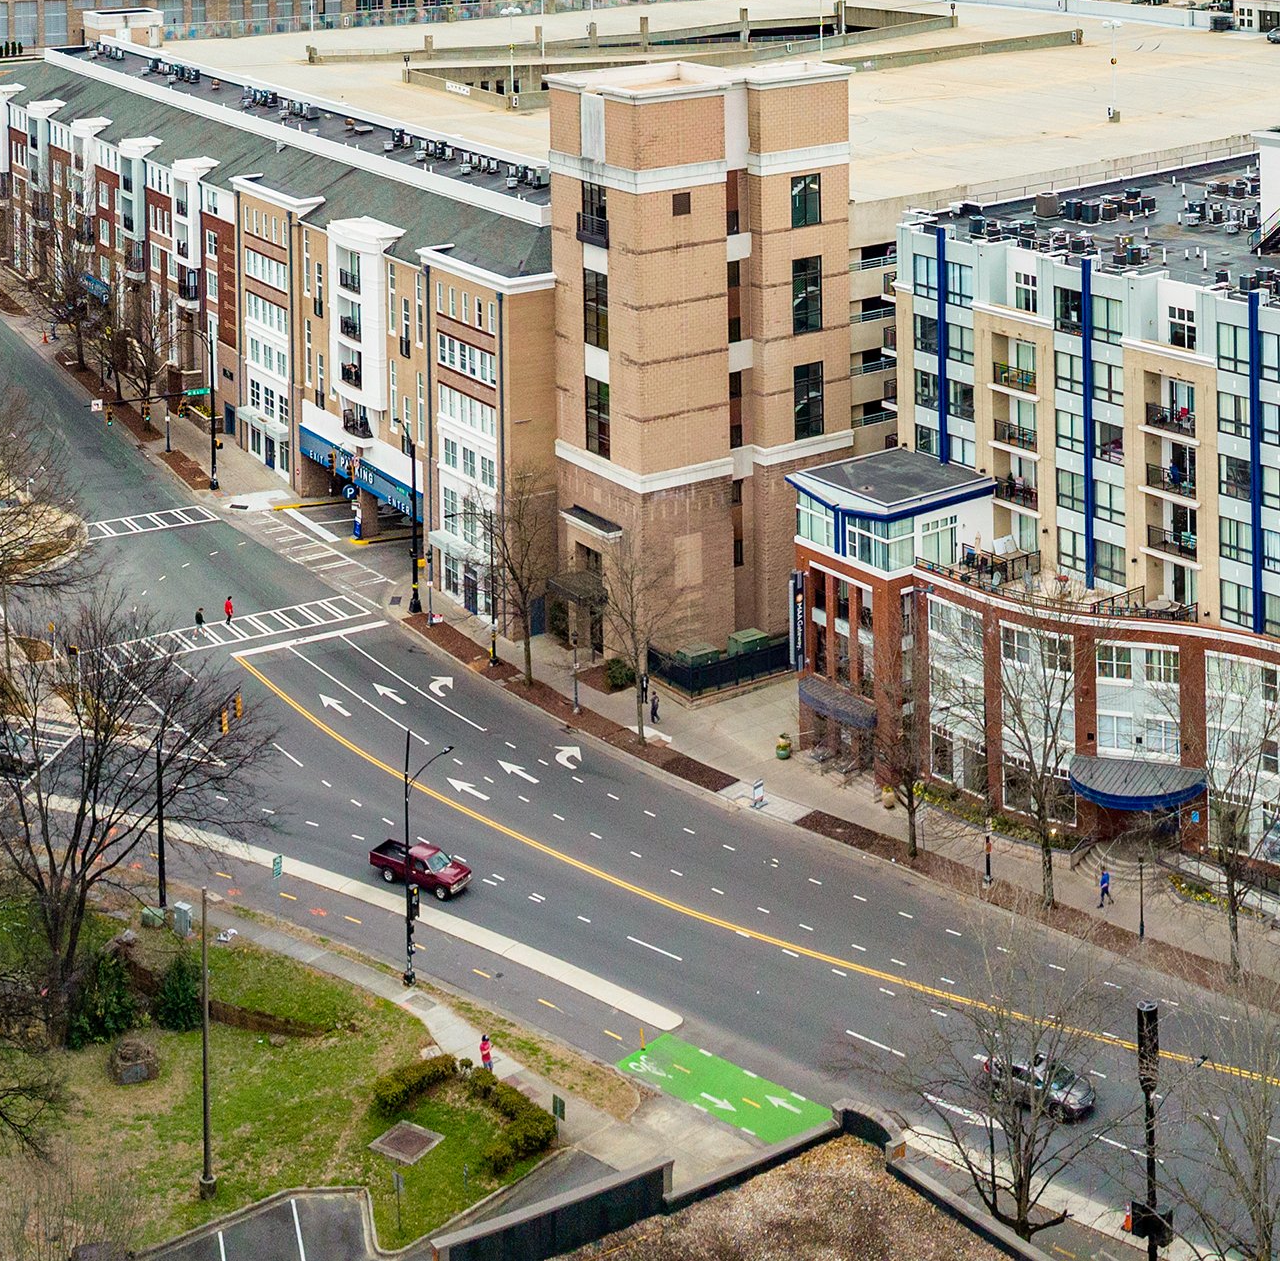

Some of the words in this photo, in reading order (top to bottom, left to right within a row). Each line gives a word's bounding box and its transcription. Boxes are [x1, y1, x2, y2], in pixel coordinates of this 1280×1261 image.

[309, 450, 324, 465] EXIT
[340, 456, 374, 485] PAKING
[347, 487, 355, 498] P
[387, 495, 411, 516] ENTER
[796, 602, 804, 620] MAA
